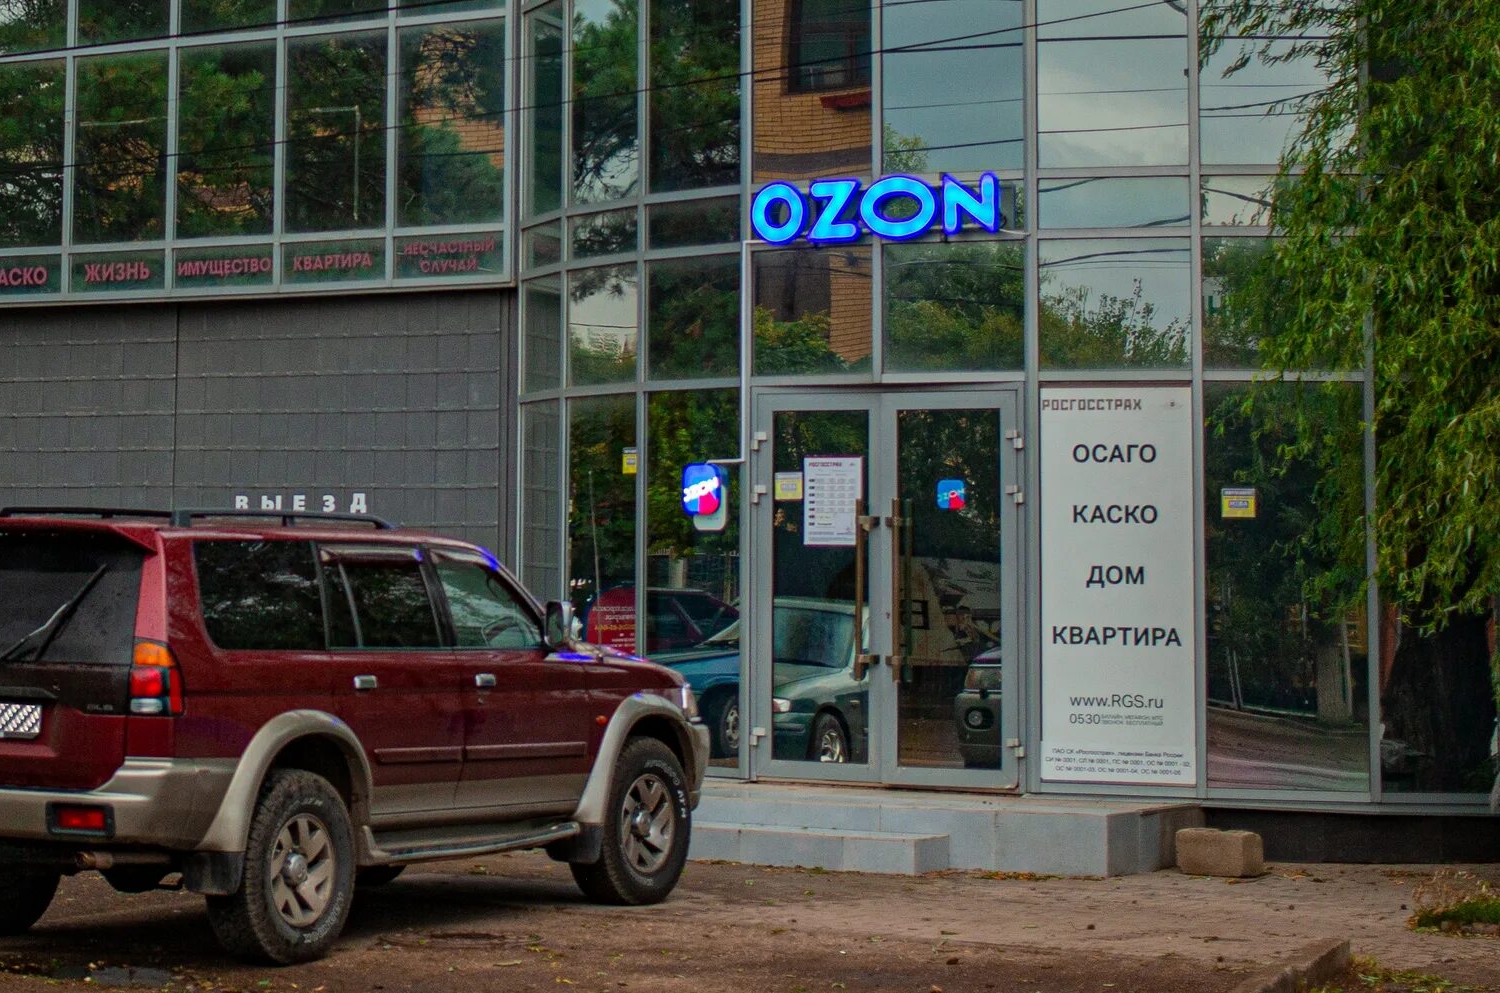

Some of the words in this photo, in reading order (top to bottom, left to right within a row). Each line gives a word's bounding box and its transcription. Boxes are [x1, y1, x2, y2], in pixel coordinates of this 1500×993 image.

[750, 170, 1000, 246] OZON
[403, 236, 495, 256] НЕСЧАСТНЫЙ
[84, 261, 150, 283] ЖИЗНЬ
[178, 256, 272, 279] ИМУЩЕСТВО
[292, 252, 373, 272] КВАРТИРА
[419, 255, 478, 274] СЛУЧАЙ
[1042, 399, 1142, 410] РОСГОССТРАХ
[1072, 444, 1157, 463] ОСАГО
[235, 492, 367, 514] ВЫЕЗД
[1072, 504, 1158, 524] КАСКО
[1086, 565, 1145, 588] ДОМ
[1052, 626, 1182, 647] КВАРТИРА
[1070, 694, 1164, 708] www.RGS.ru
[1069, 713, 1101, 725] 0530
